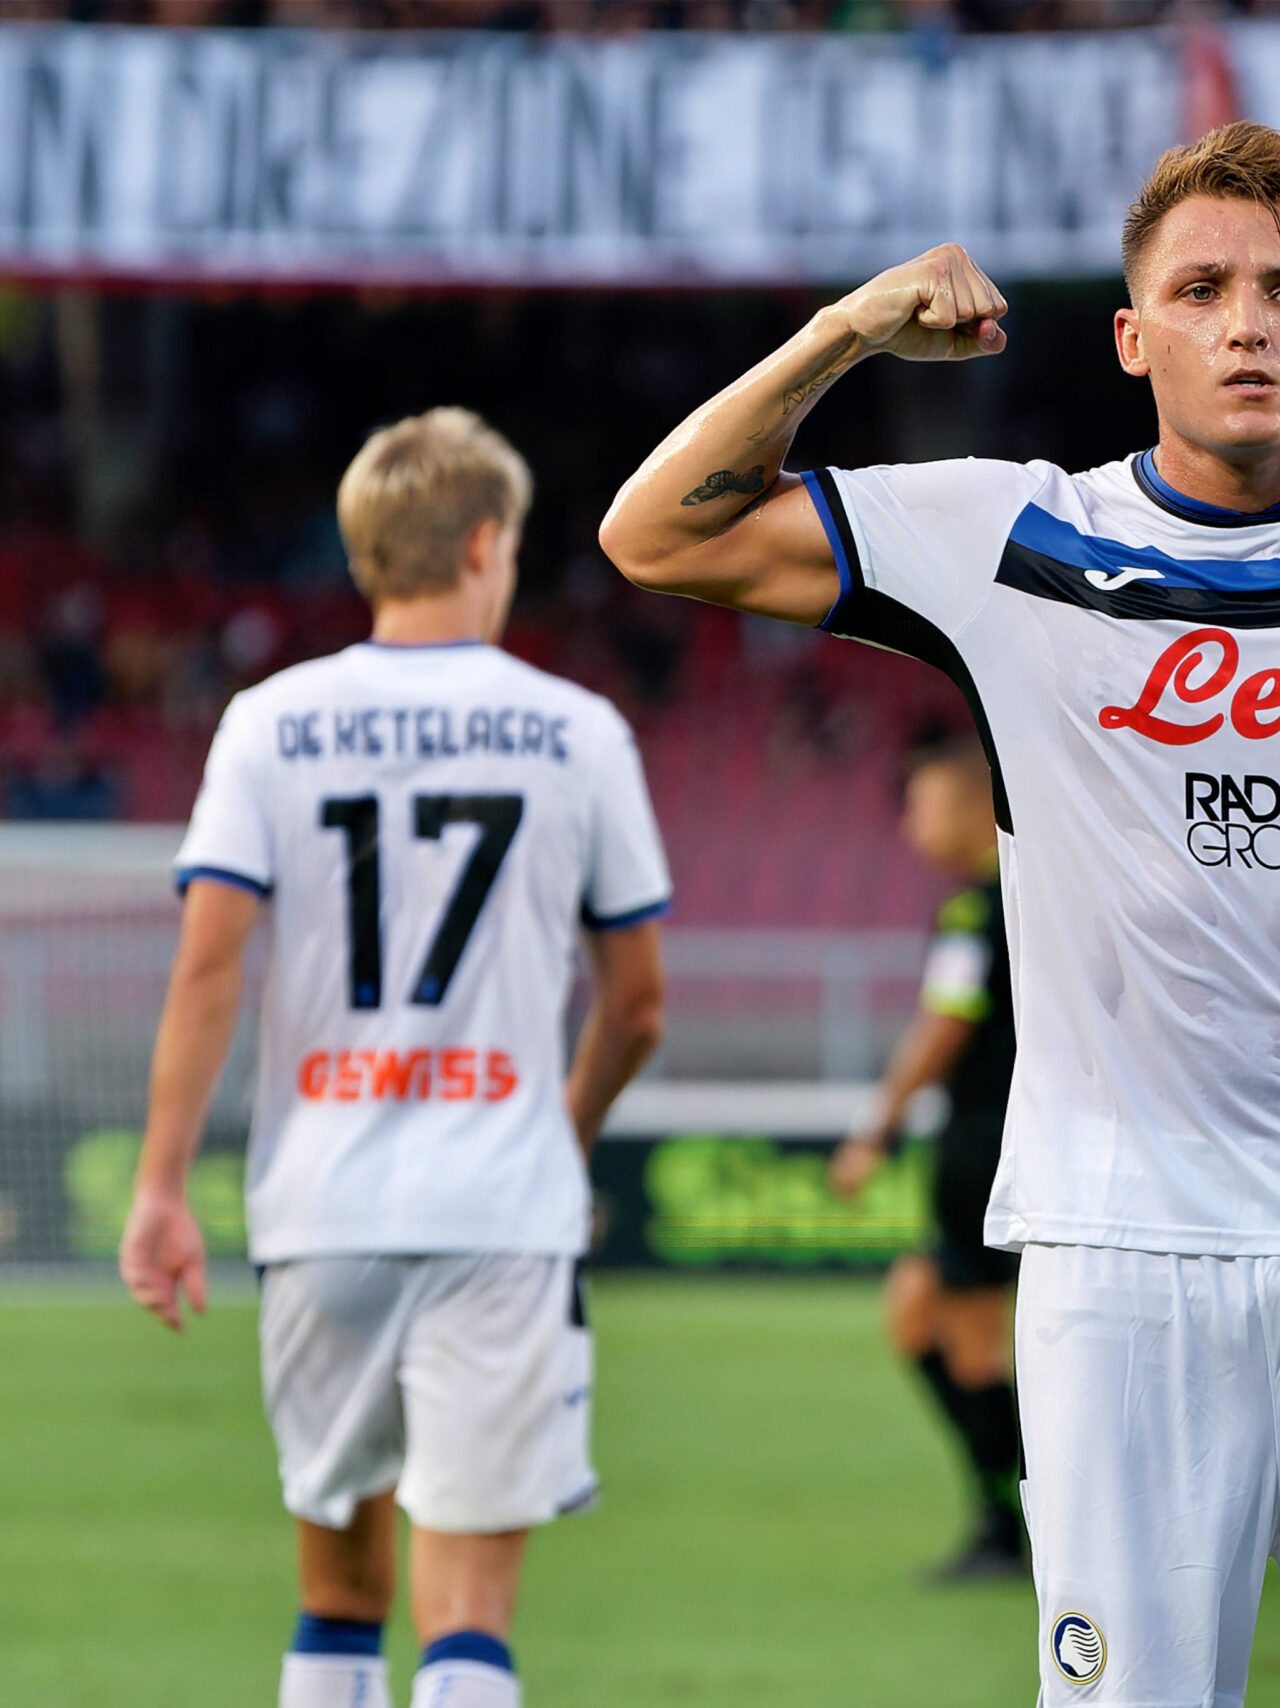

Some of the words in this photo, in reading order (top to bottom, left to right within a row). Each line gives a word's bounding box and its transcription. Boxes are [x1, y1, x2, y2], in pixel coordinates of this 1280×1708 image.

[277, 711, 324, 762] DE
[334, 706, 571, 767] KETELAERE
[318, 793, 525, 1011] 17
